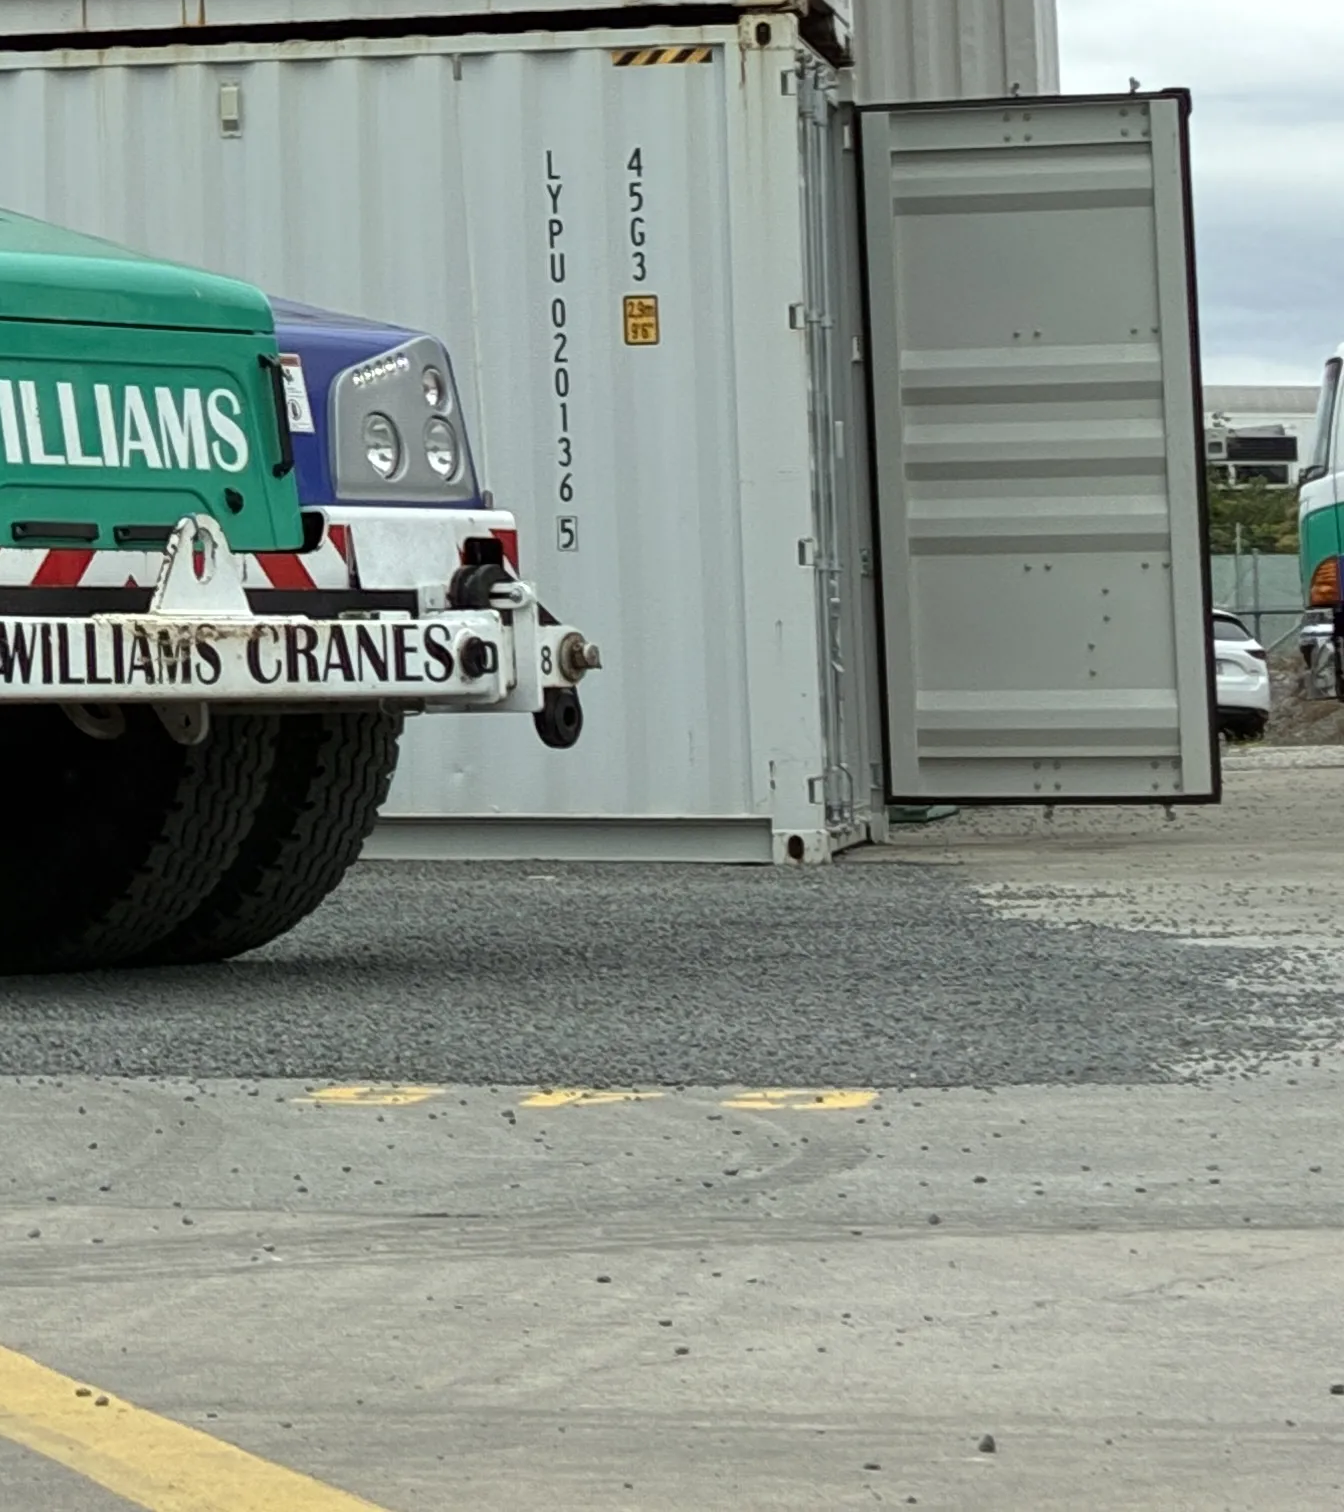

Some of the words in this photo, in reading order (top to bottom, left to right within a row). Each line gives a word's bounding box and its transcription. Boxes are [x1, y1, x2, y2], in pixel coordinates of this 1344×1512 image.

[545, 150, 566, 284] LYPU
[626, 147, 647, 282] 45G3
[551, 298, 574, 503] 020136
[246, 622, 455, 684] CRANES
